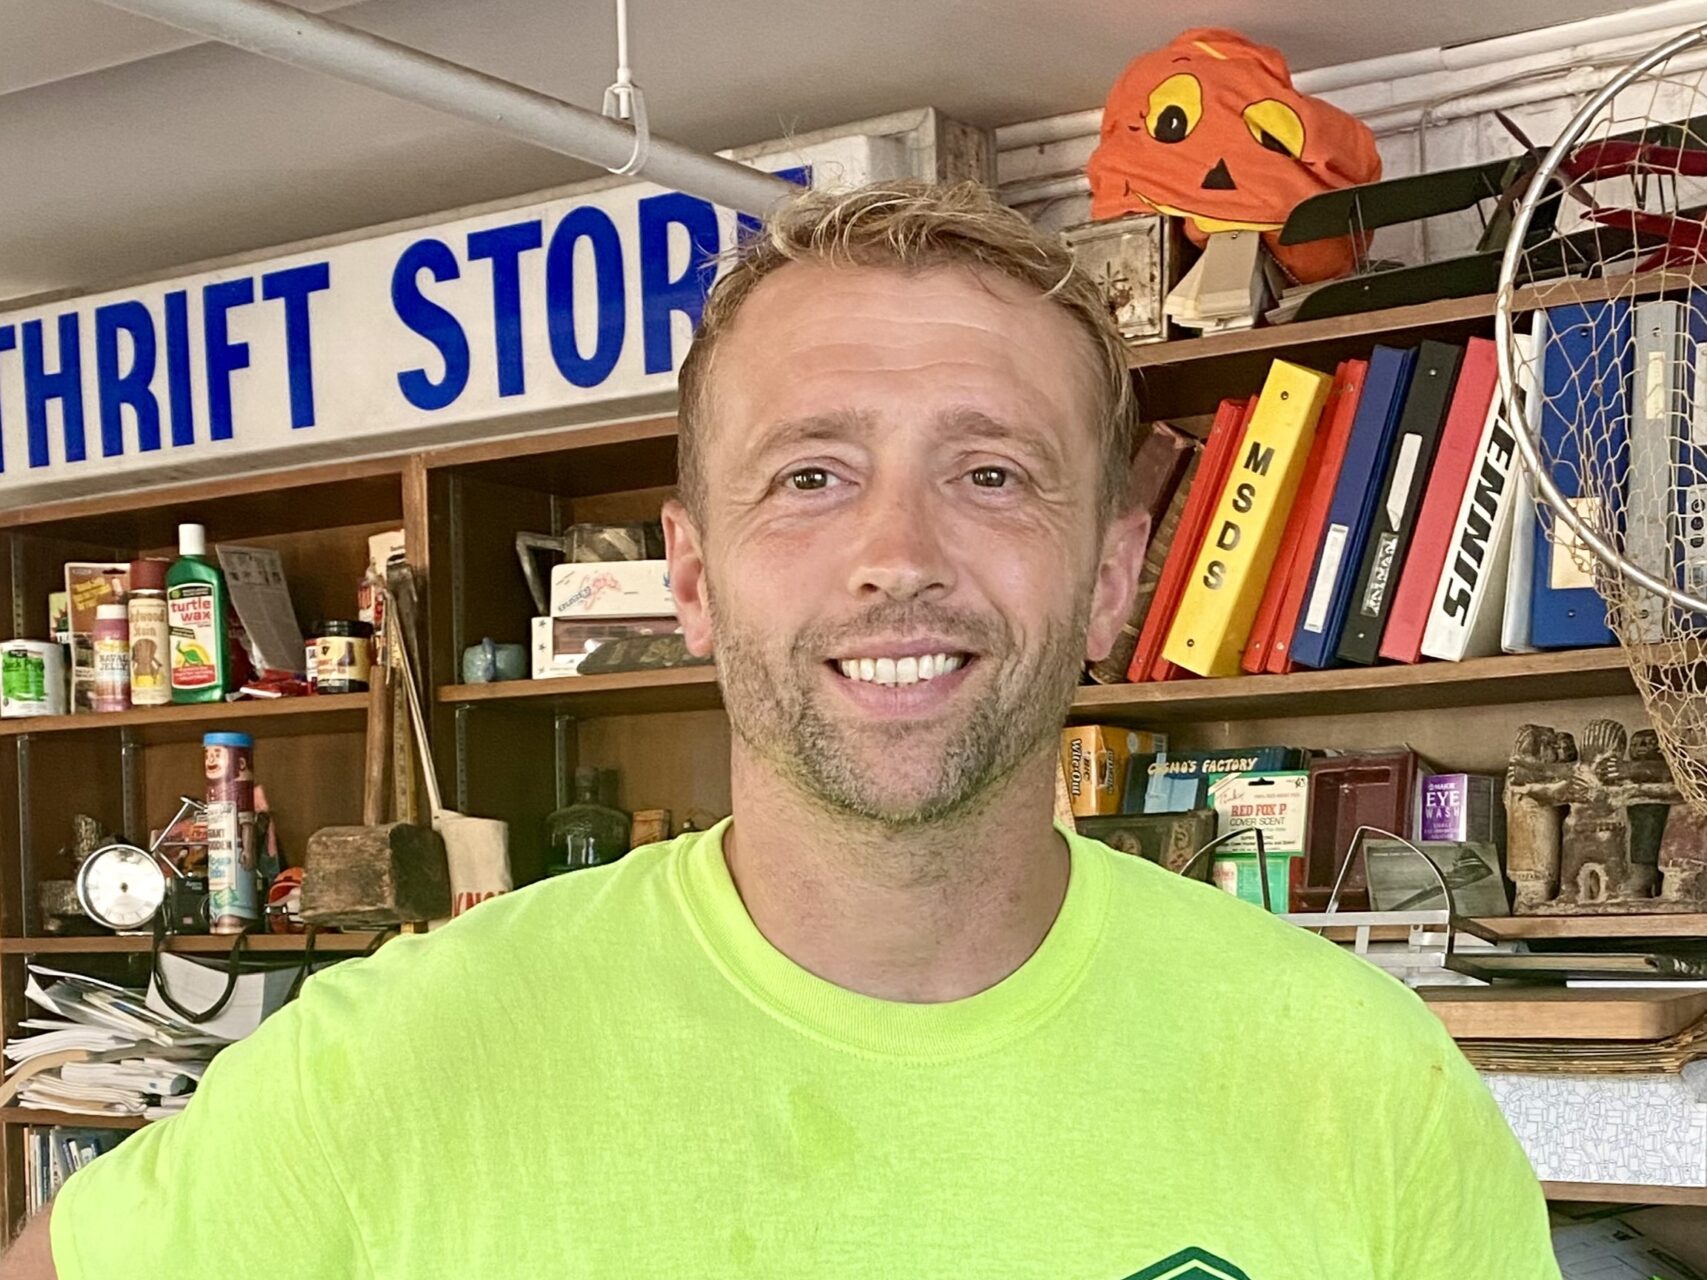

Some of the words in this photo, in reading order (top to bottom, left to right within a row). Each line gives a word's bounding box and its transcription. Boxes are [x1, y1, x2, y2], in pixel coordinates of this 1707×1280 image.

[0, 261, 330, 473] THRIFT
[391, 165, 813, 411] STOR
[1203, 442, 1276, 590] MSDS
[170, 597, 212, 613] turtle
[180, 610, 212, 622] wax
[99, 662, 129, 671] JELLY
[1201, 757, 1259, 774] FACTORY
[1426, 791, 1460, 807] EYE
[1231, 804, 1254, 817] RED
[1255, 803, 1277, 817] FOX
[1425, 807, 1461, 819] WASH
[1229, 816, 1257, 827] COVER
[1258, 816, 1286, 826] SCENT
